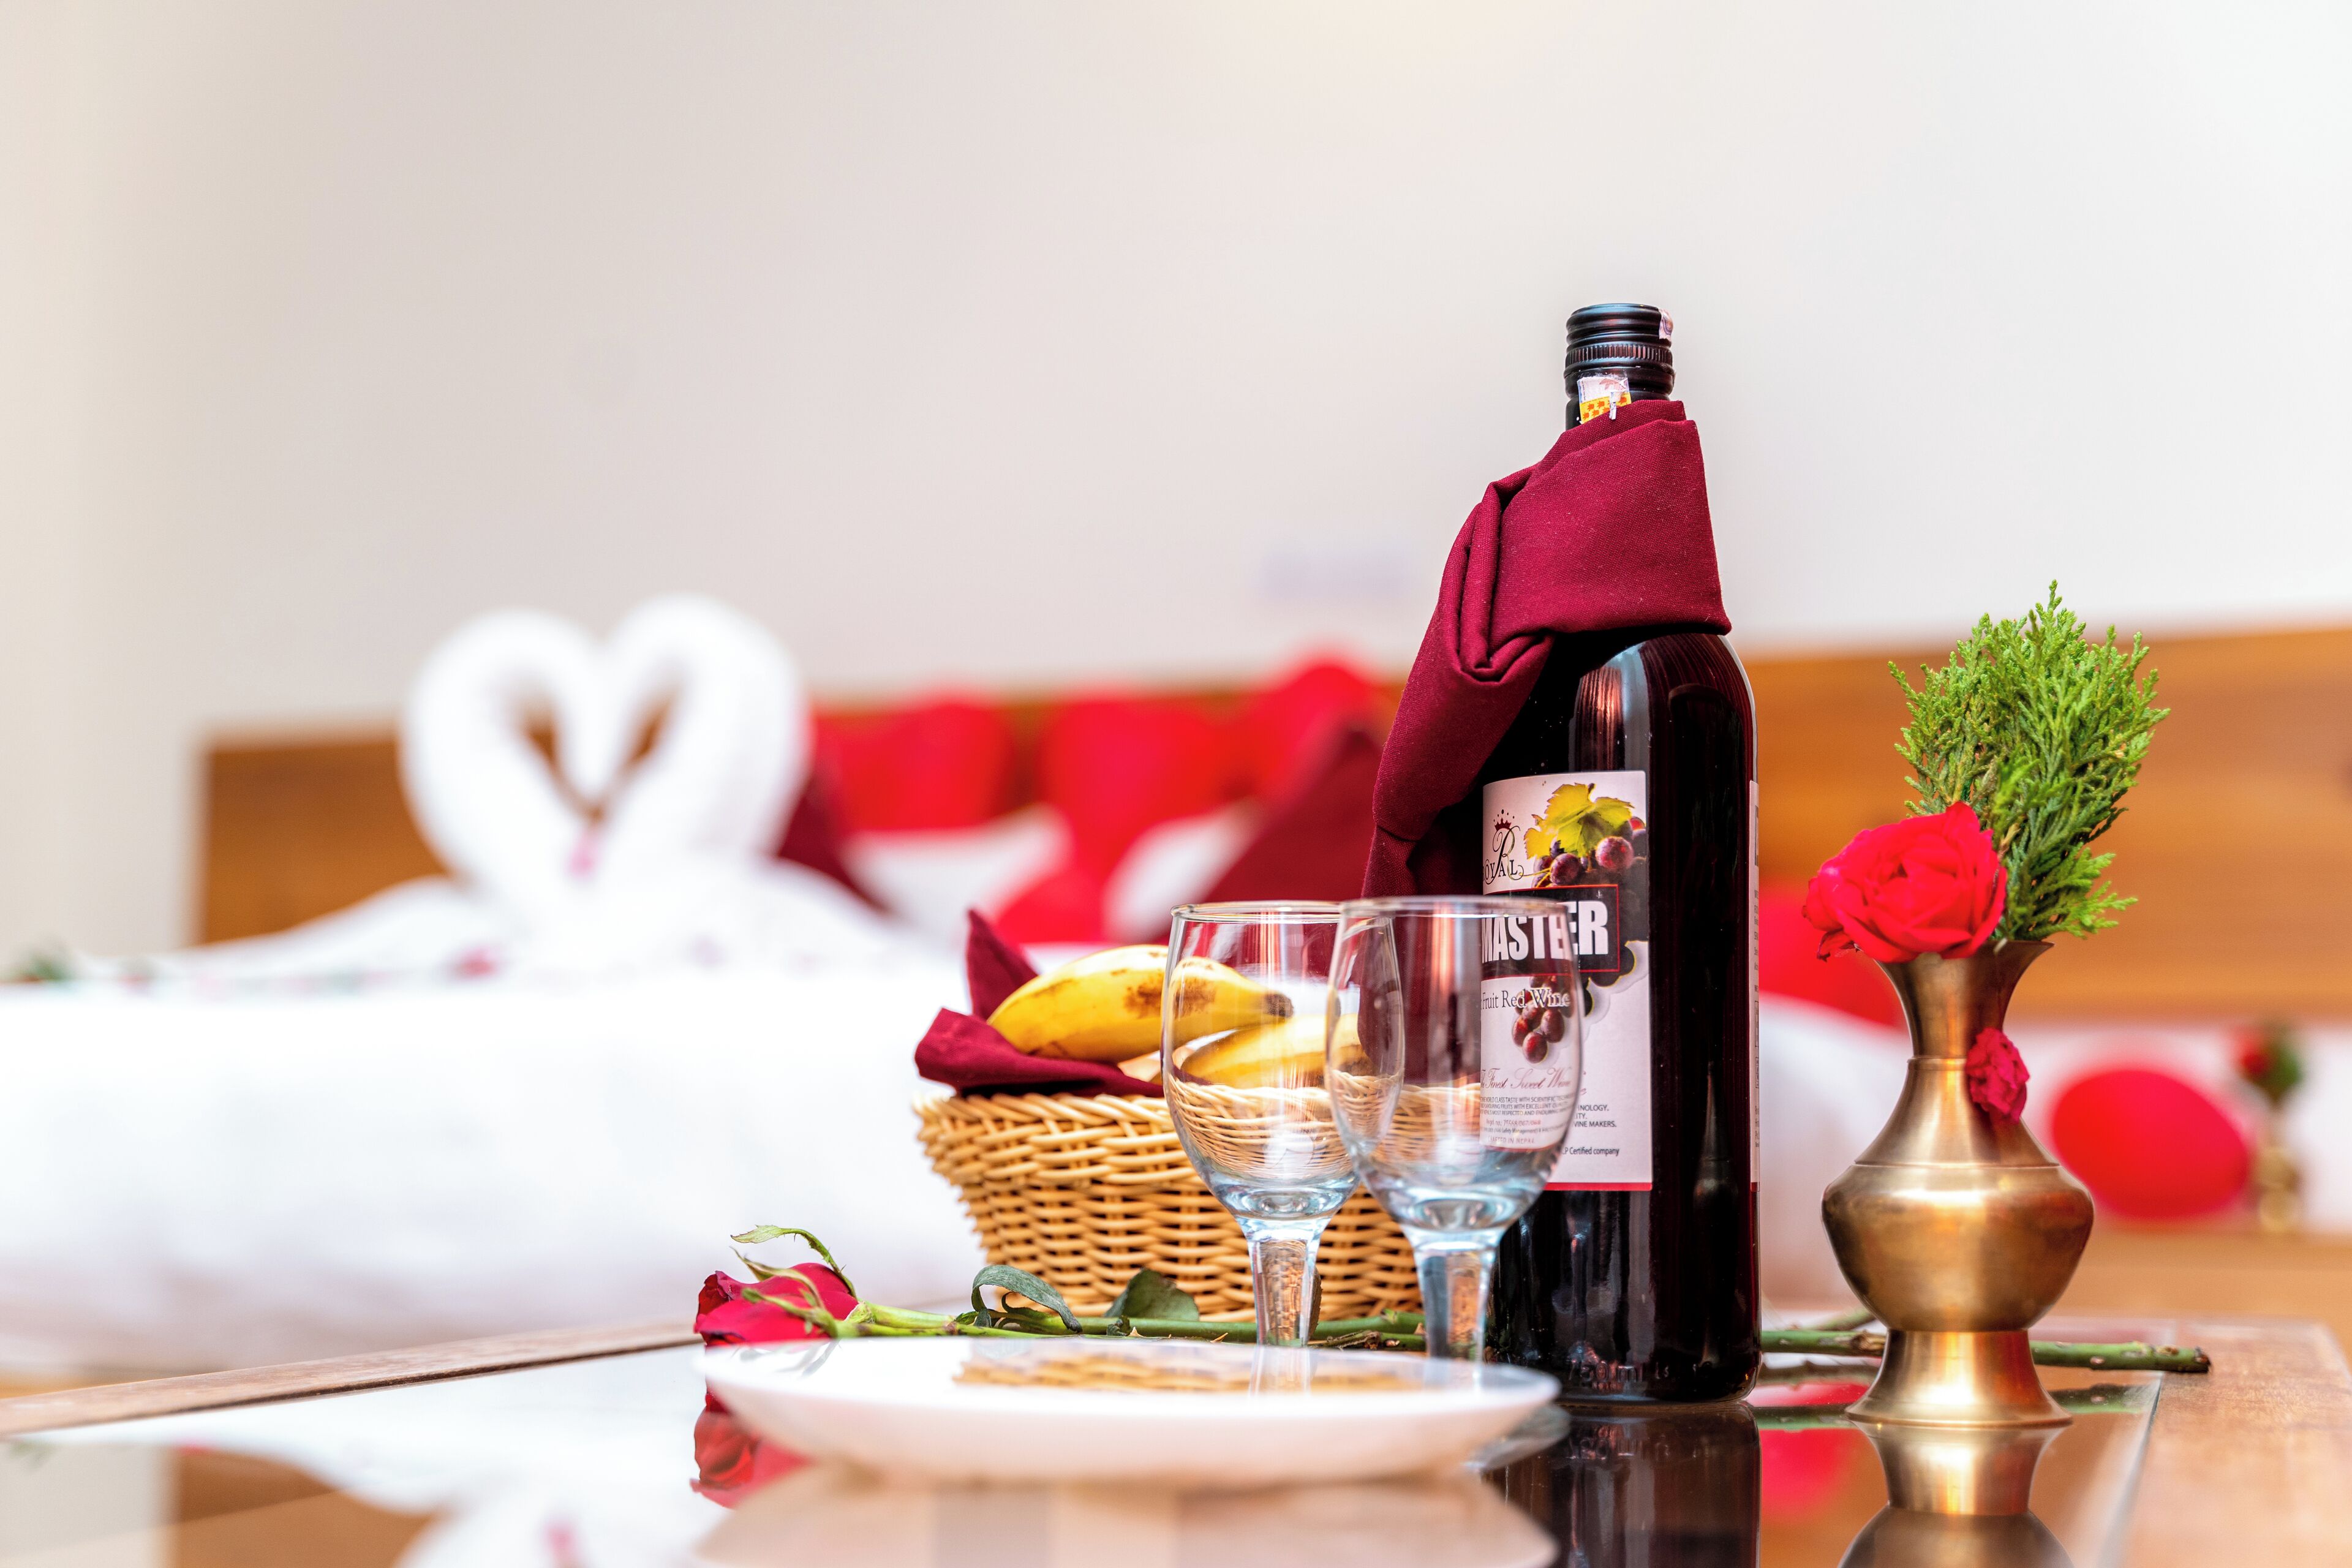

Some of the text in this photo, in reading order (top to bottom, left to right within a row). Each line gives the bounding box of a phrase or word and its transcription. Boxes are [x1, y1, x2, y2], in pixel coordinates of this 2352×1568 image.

[1482, 901, 1608, 963] MASTER
[1482, 987, 1570, 1009] Fruit Red Wine
[1485, 1068, 1509, 1088] Finest
[1510, 1068, 1546, 1089] Sweet
[1569, 1146, 1593, 1155] Certified
[1593, 1147, 1620, 1157] company
